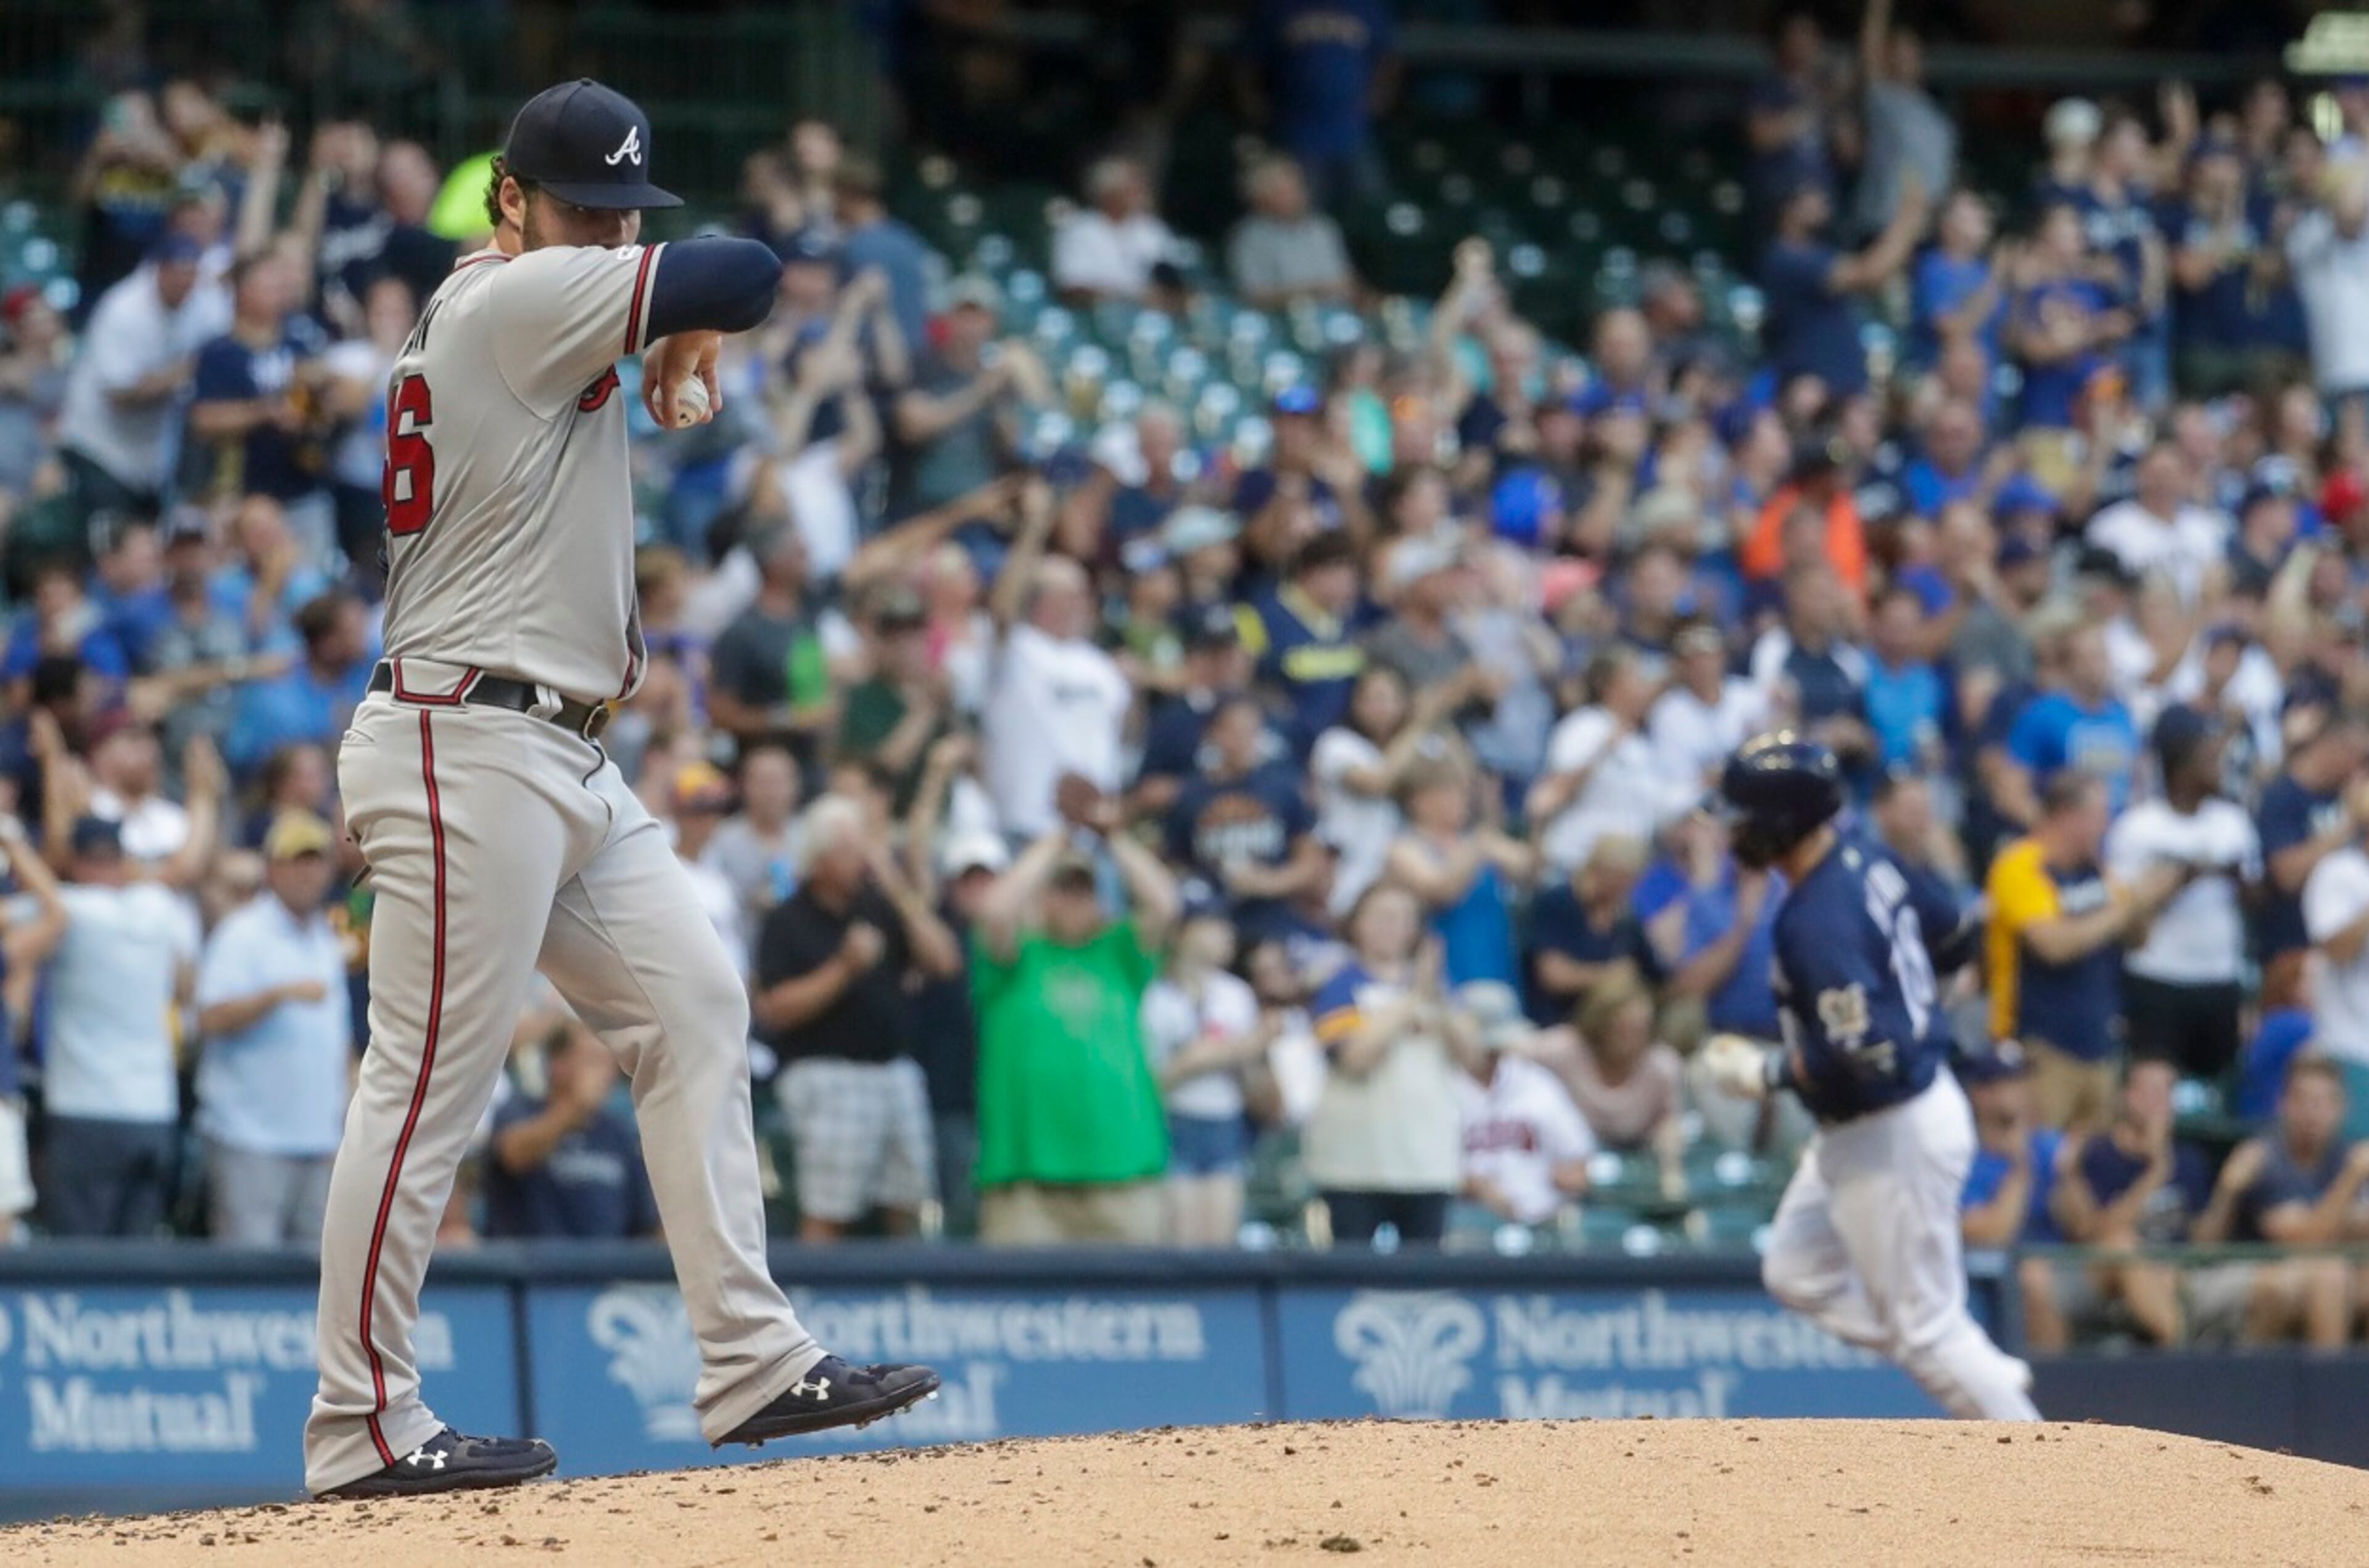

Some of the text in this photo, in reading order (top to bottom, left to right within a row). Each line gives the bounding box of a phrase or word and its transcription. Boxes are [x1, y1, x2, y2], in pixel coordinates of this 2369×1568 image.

[606, 125, 641, 165] A
[382, 373, 434, 538] 6
[22, 1289, 455, 1370] Northwesn
[791, 1283, 1206, 1361] orthwestern
[27, 1374, 257, 1451] Mutual
